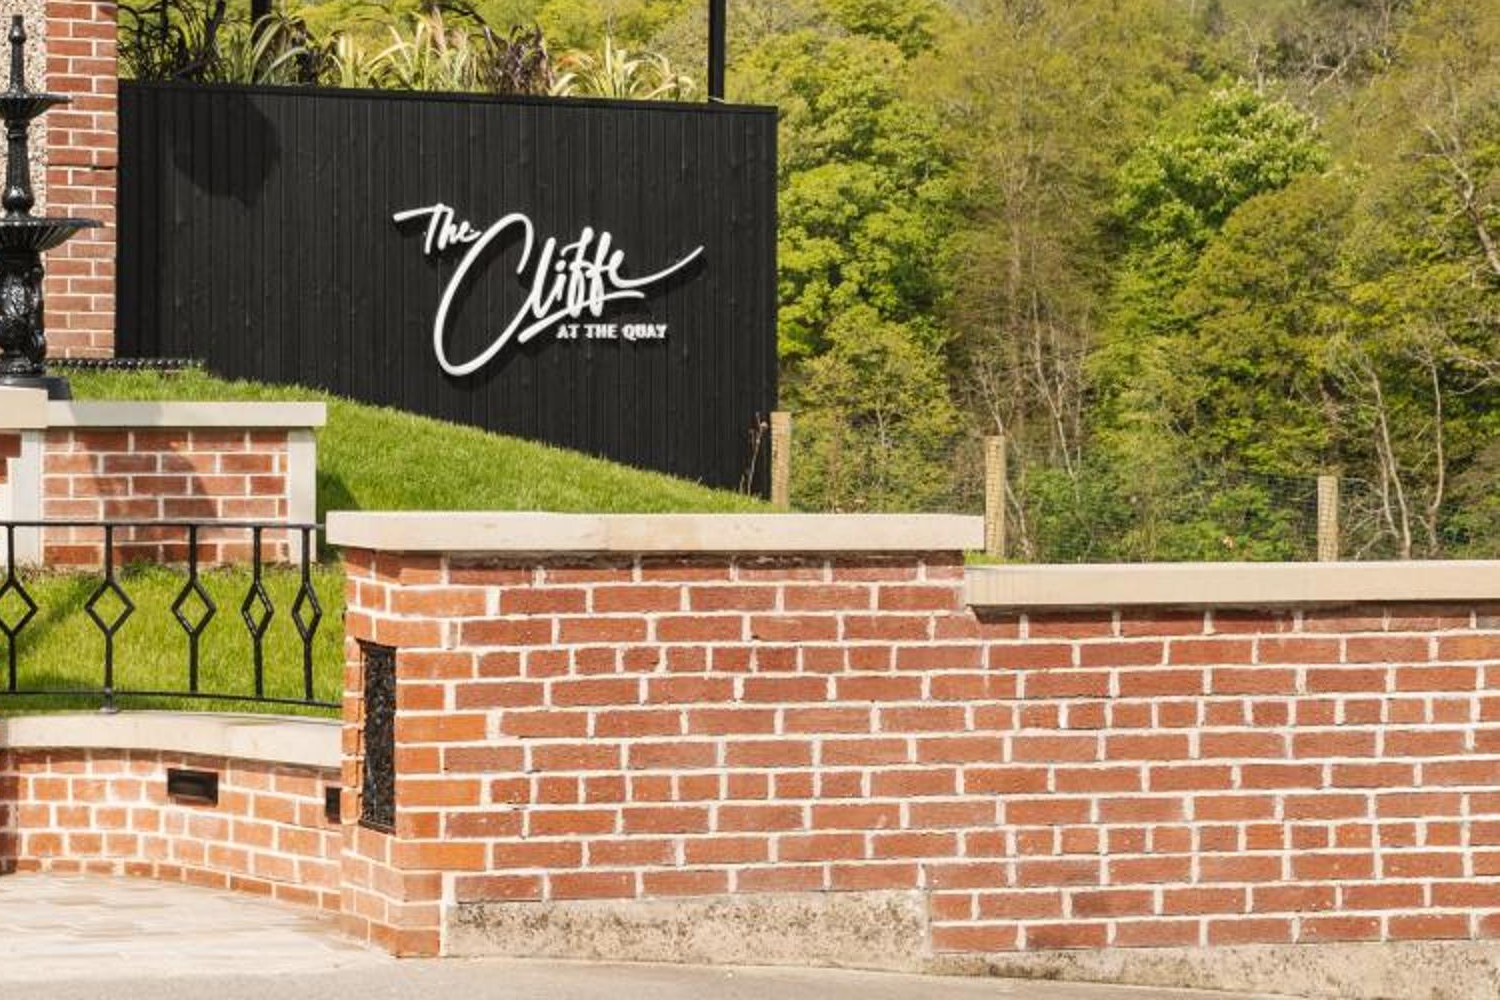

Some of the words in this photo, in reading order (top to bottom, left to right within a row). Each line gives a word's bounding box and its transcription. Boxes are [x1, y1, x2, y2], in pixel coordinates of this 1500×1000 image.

[393, 203, 481, 254] The
[433, 213, 704, 376] Cliffe
[556, 323, 579, 339] AT
[583, 323, 618, 339] THE
[621, 323, 667, 341] QUAY
